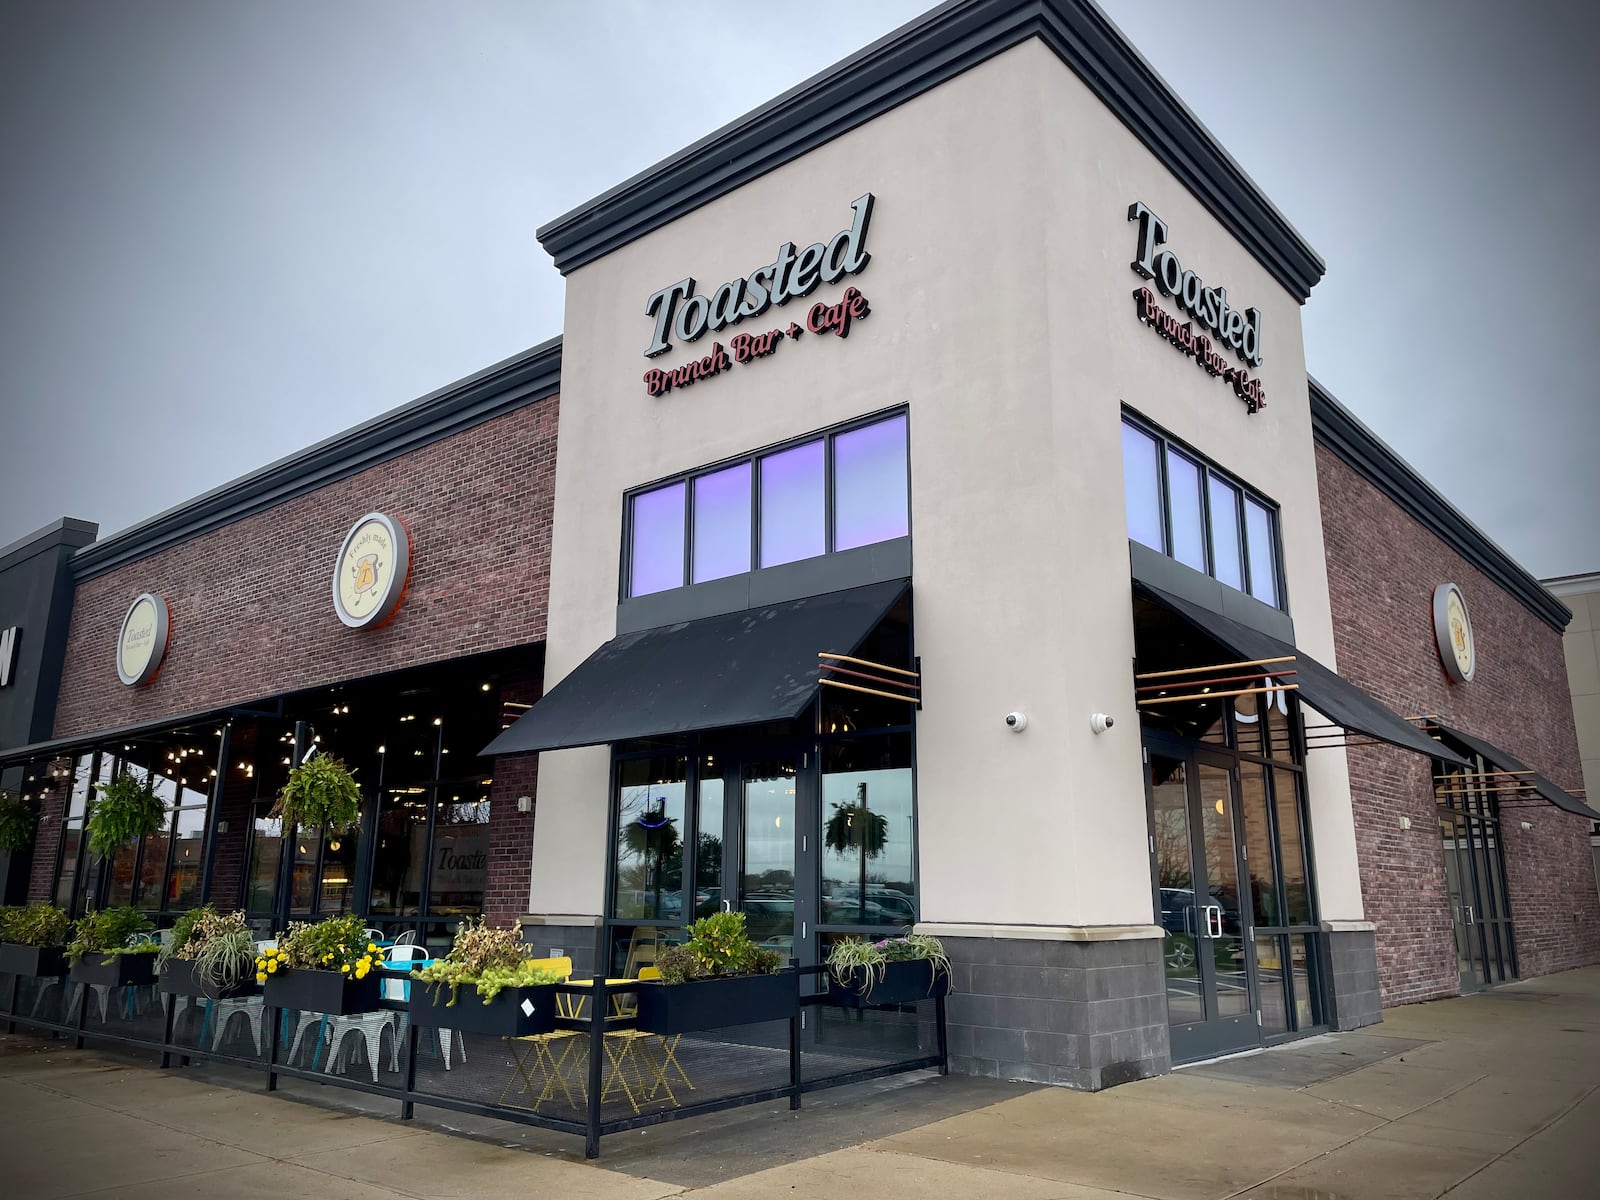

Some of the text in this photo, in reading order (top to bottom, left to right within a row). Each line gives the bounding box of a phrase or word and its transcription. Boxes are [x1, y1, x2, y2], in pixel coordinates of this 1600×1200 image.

[643, 192, 876, 358] Toasted
[643, 341, 732, 398] Brunch
[730, 328, 784, 365] Bar
[806, 286, 871, 340] Cafe
[1128, 200, 1263, 369] Toasted
[1132, 286, 1199, 358] Brunch
[1196, 334, 1228, 378] Bar
